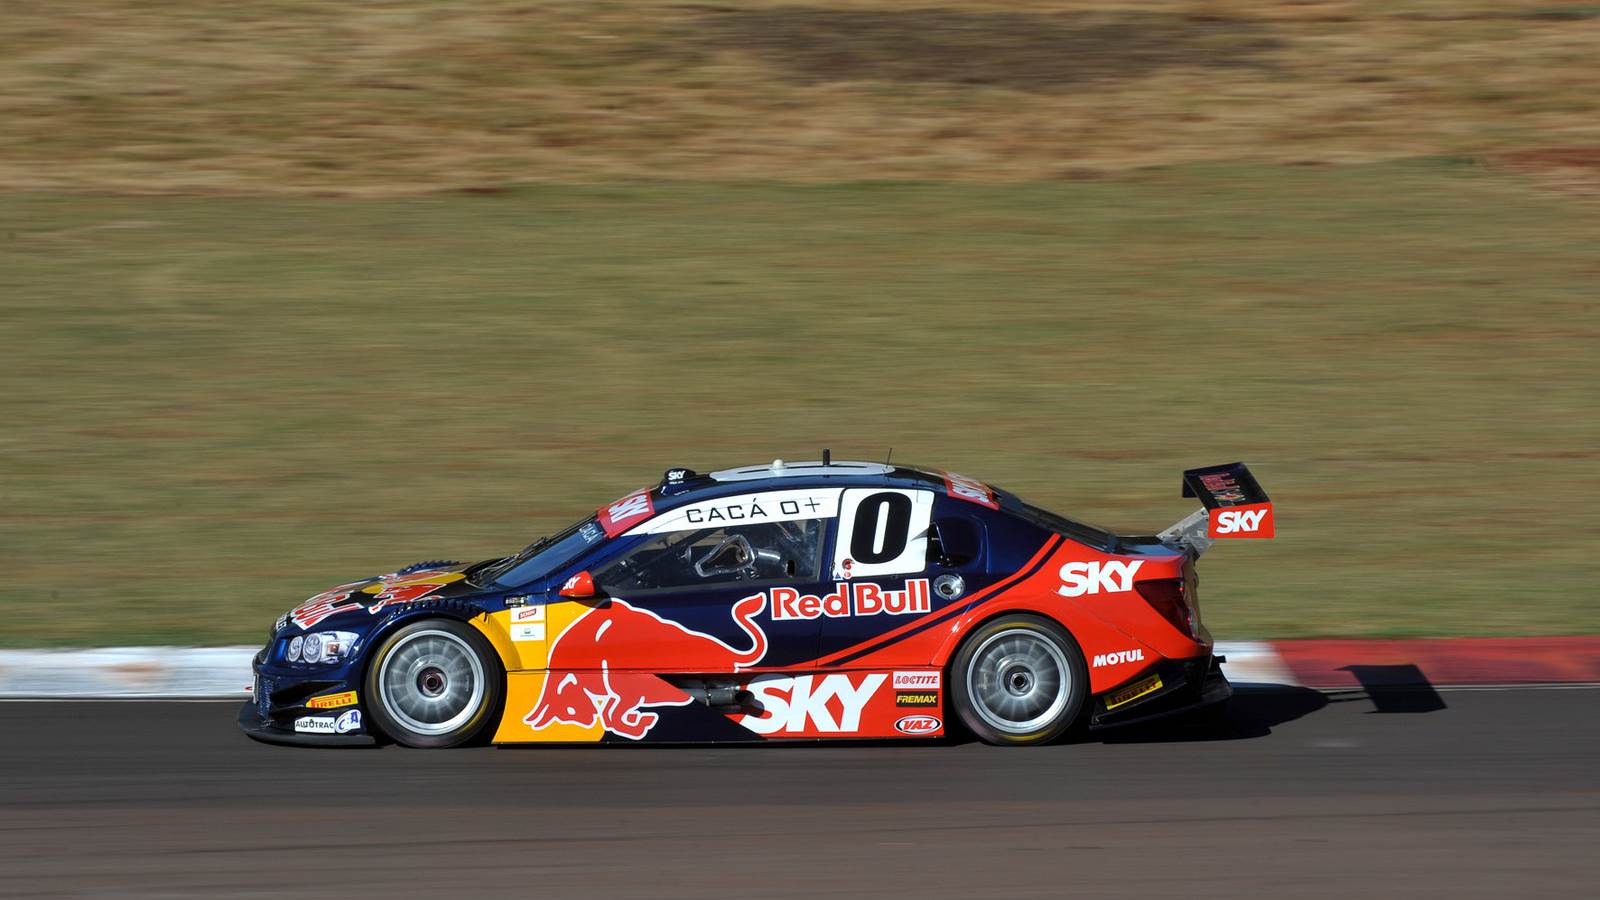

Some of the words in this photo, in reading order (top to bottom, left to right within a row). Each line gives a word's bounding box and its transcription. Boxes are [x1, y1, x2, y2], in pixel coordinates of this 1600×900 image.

[668, 470, 686, 481] SKY
[686, 497, 768, 523] CACÁ
[849, 491, 913, 564] 0
[1216, 509, 1268, 534] SKY
[1057, 560, 1145, 597] SKY
[770, 582, 851, 621] Red
[853, 577, 933, 617] Bull
[1092, 648, 1145, 667] MOTUL
[895, 675, 938, 684] LOCTITE
[310, 692, 352, 708] PIRELLI
[739, 673, 889, 734] SKY
[896, 695, 937, 703] FREMAX
[296, 719, 335, 730] AUTOTRAC
[902, 719, 934, 731] VAZ
